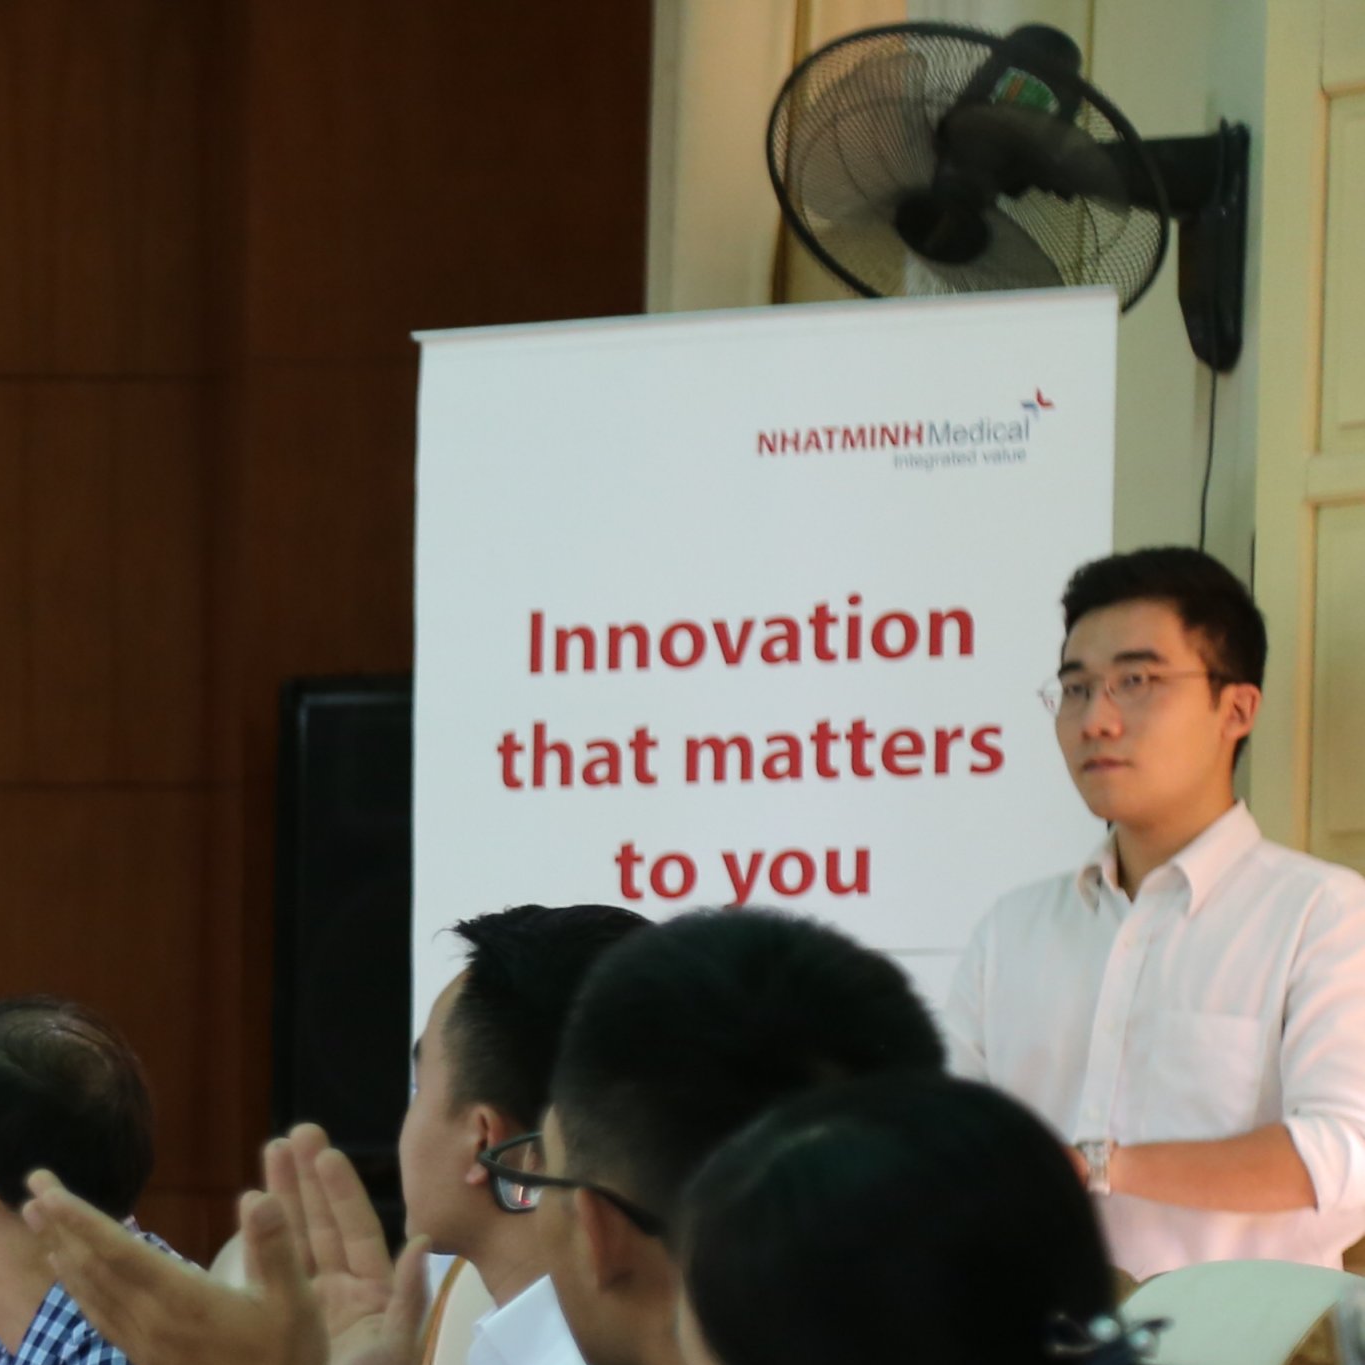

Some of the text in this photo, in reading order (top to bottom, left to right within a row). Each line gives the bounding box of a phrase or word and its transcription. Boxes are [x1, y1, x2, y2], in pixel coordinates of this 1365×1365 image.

[527, 592, 974, 674] Innovation
[498, 719, 1005, 789] that matters
[615, 841, 870, 909] to you
